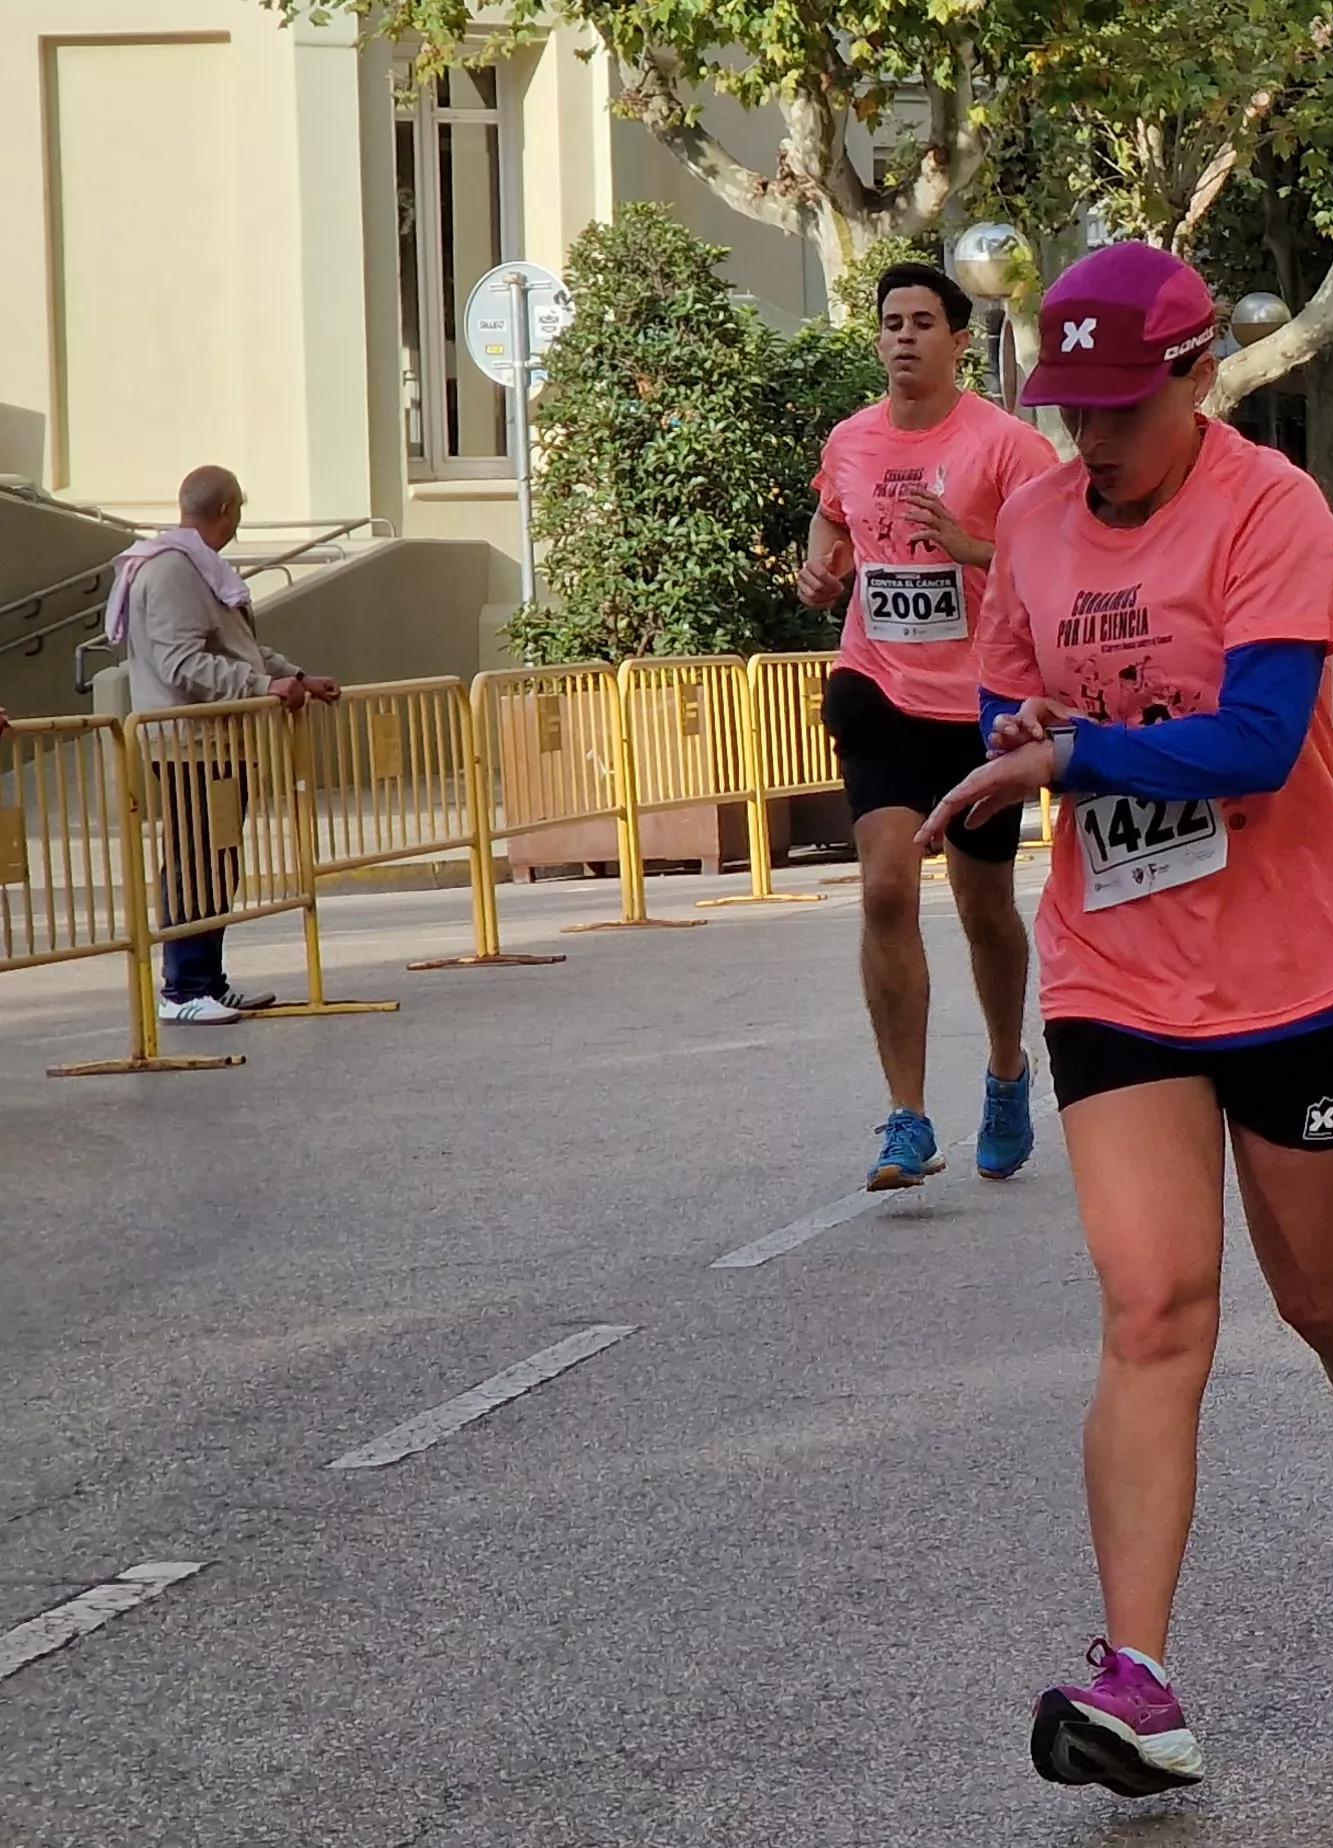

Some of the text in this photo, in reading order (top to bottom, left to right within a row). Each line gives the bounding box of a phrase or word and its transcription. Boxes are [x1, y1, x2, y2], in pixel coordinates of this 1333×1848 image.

[870, 591, 956, 620] 2004
[1057, 618, 1080, 648] POR
[1082, 616, 1096, 644] LA
[1100, 606, 1149, 642] CIENCIA
[1084, 798, 1209, 862] 1422
